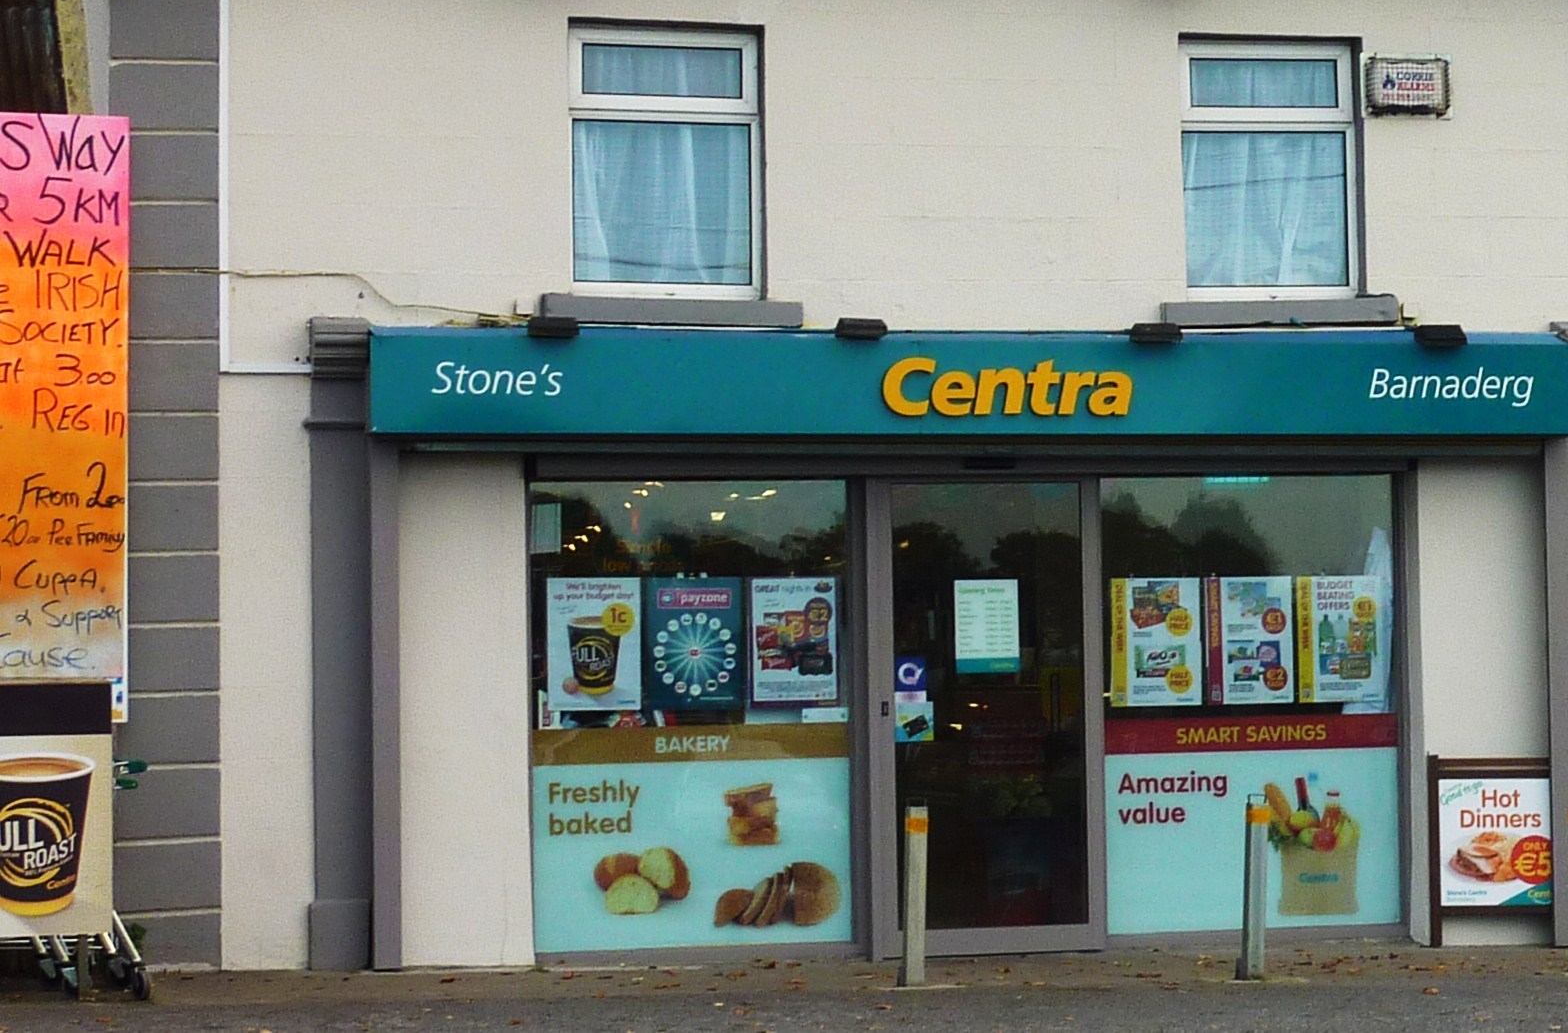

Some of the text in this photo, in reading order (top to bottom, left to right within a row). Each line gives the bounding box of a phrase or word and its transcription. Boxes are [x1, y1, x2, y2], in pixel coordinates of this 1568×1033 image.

[3, 228, 117, 268] WALK
[36, 269, 123, 313] IRISH
[431, 356, 1535, 417] Stone's Centra Barnaderg
[1316, 581, 1353, 590] BUDGET
[1316, 591, 1355, 600] BEATING
[680, 592, 728, 606] payzone
[1316, 601, 1351, 611] OFFERS
[610, 607, 627, 624] 1c
[655, 735, 731, 754] BAKERY
[1176, 724, 1327, 745] SMART SAVINGS
[548, 779, 640, 808] Freshly
[1117, 770, 1229, 798] Amazing
[1481, 789, 1521, 808] Hot
[548, 810, 633, 836] baked
[1117, 801, 1187, 826] value
[1459, 808, 1543, 829] Dinners
[24, 832, 77, 870] ROAST
[1523, 841, 1548, 851] ONLY
